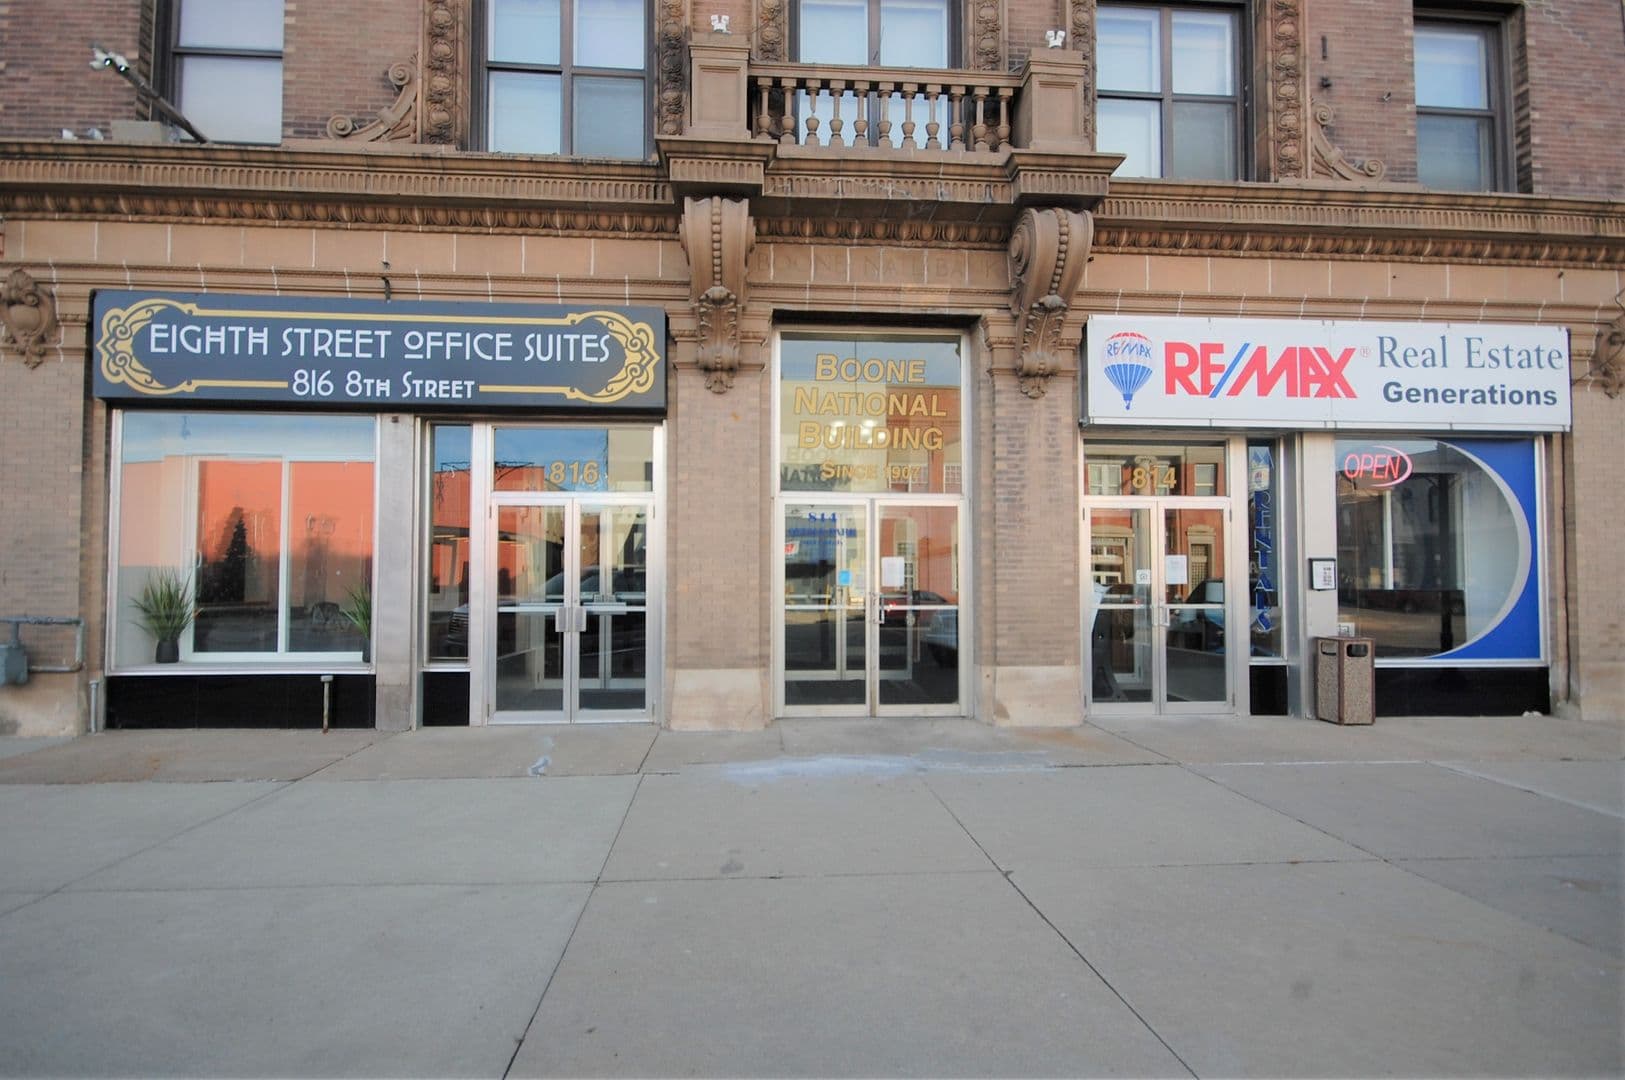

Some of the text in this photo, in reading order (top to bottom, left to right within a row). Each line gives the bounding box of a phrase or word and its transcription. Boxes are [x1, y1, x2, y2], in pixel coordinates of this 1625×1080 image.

[150, 323, 611, 363] EIGHTH STREET OFFICE SUITES
[1107, 340, 1153, 360] RE/MAX
[1377, 334, 1564, 371] Real Estate
[292, 368, 475, 399] 816 8TH STREET
[815, 353, 926, 384] BOONE
[1164, 341, 1358, 399] RE/MAX
[793, 387, 947, 417] NATIONAL
[1383, 381, 1558, 406] Generations
[798, 421, 944, 451] BUILDING
[550, 459, 600, 485] 816
[1131, 466, 1177, 489] 814
[1344, 453, 1402, 480] OPEN
